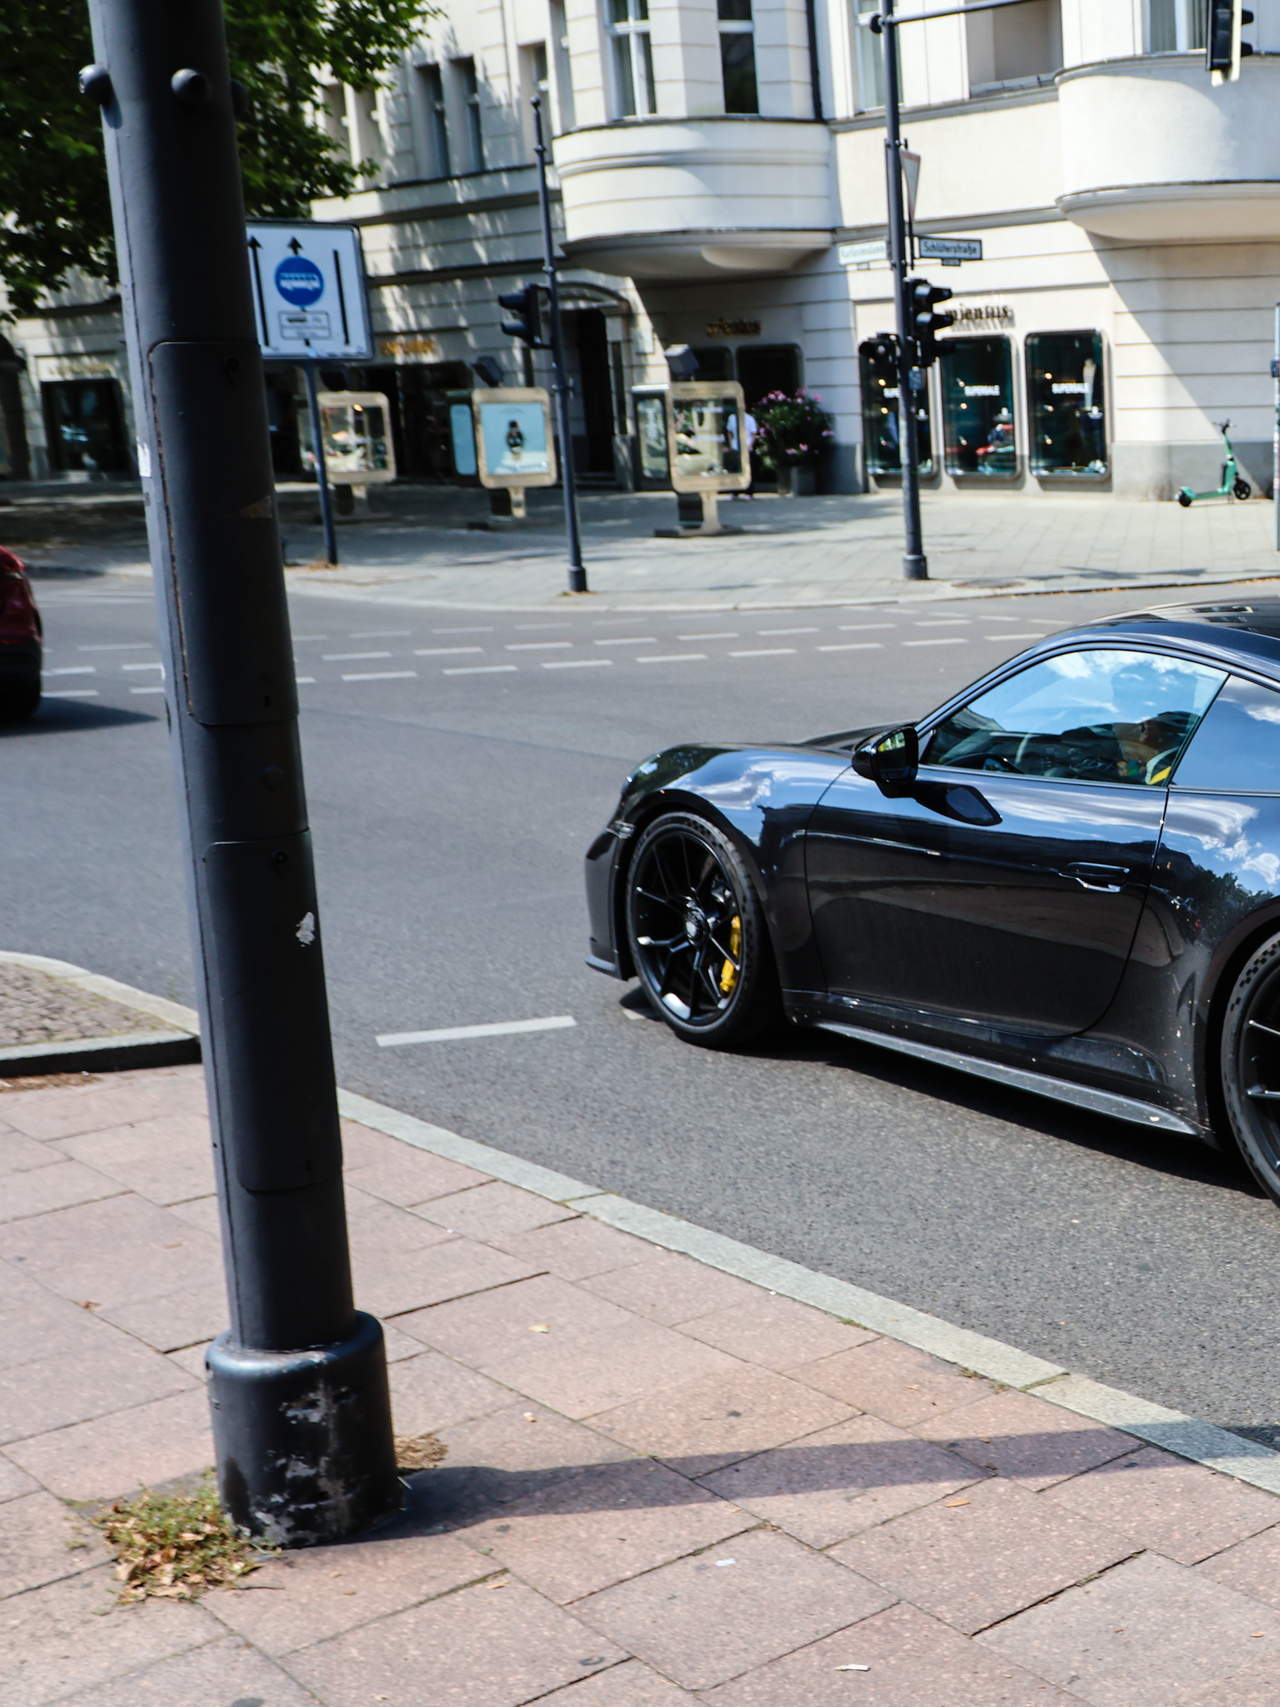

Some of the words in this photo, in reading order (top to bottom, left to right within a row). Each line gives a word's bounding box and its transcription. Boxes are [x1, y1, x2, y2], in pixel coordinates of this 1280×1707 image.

[923, 240, 977, 256] Schlüterstraße
[964, 385, 1000, 396] SUPERSALE
[1052, 382, 1090, 394] SUPERSALE
